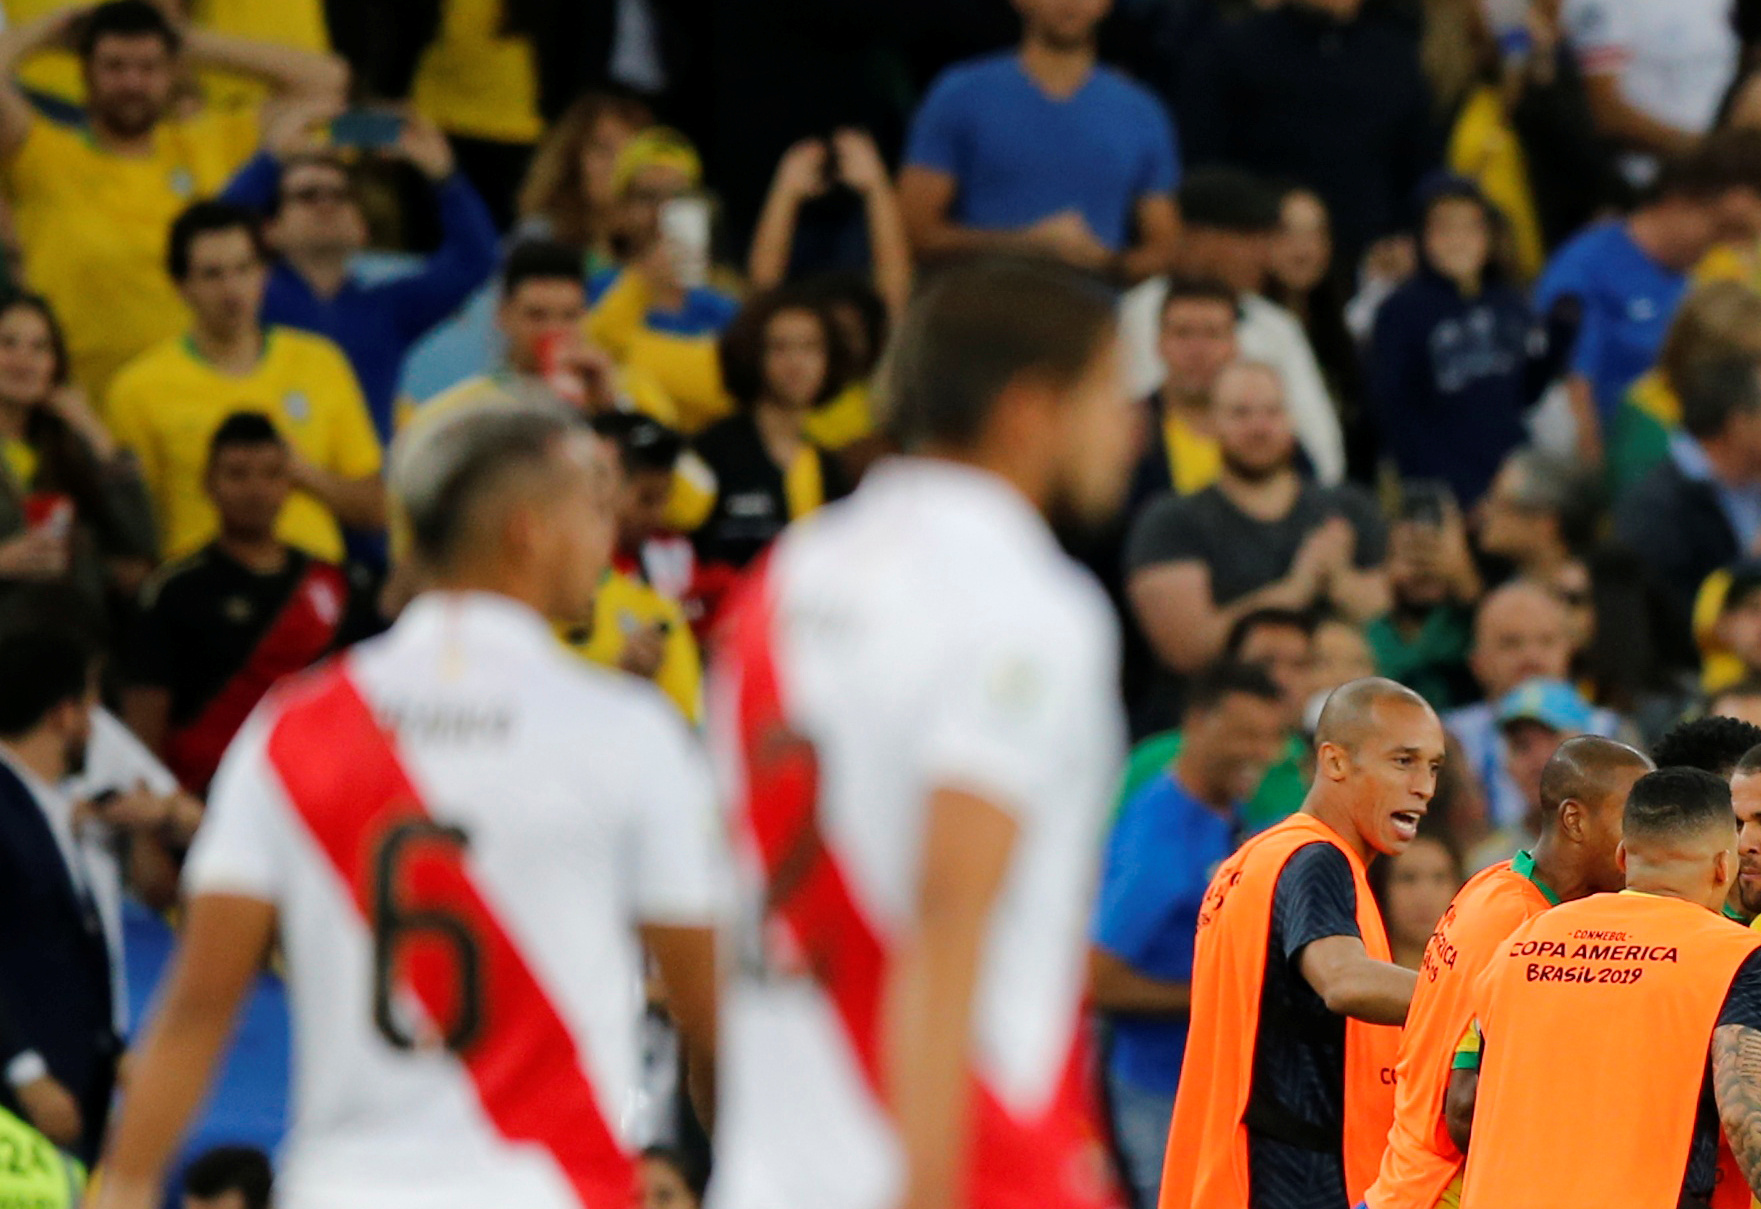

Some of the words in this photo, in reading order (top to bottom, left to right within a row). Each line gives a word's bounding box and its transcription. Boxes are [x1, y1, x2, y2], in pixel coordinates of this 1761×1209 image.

[371, 818, 482, 1053] 6
[1573, 929, 1628, 942] CONMEBOL
[1571, 943, 1679, 964] AMERICA
[1597, 967, 1644, 985] 2019
